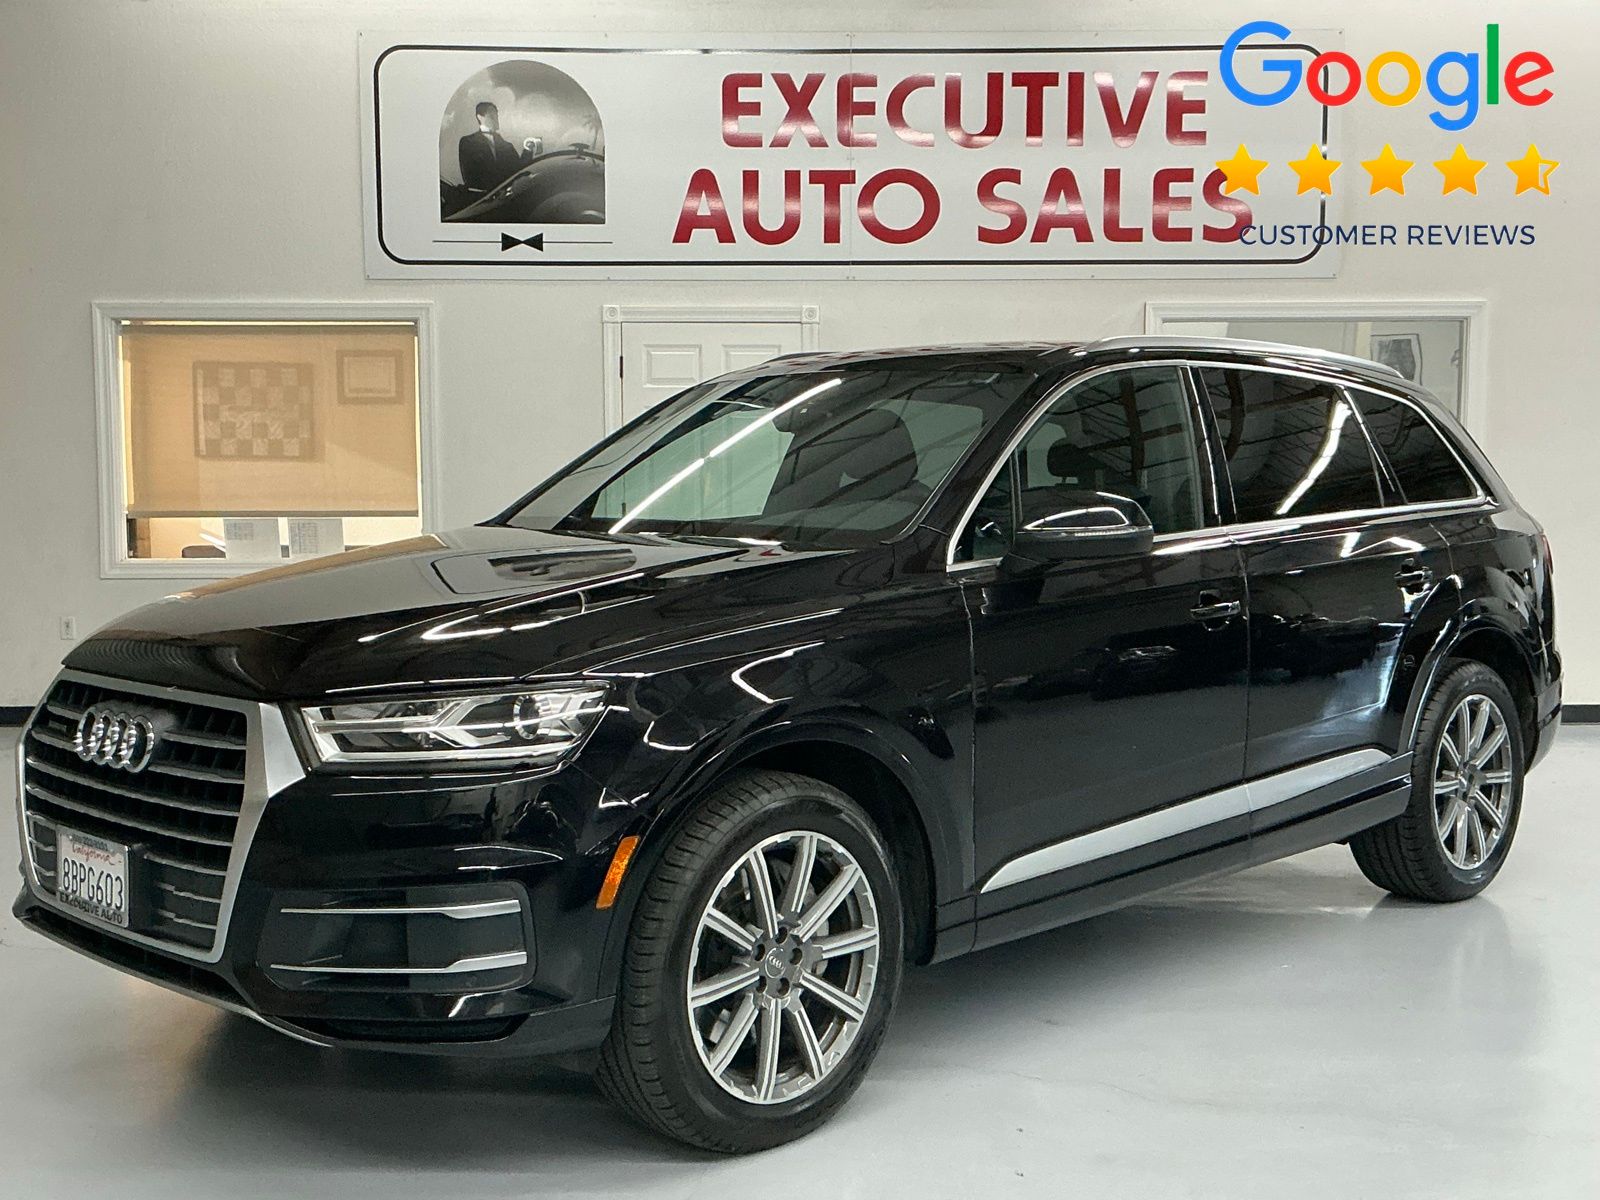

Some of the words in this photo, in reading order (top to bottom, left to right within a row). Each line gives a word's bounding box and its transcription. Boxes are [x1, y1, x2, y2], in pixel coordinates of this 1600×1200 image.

[722, 71, 1209, 148] EXECUTIVE
[672, 168, 941, 245] AUTO
[977, 167, 1253, 245] SALES
[62, 856, 124, 911] 8BPG603
[101, 906, 123, 925] AUTO
